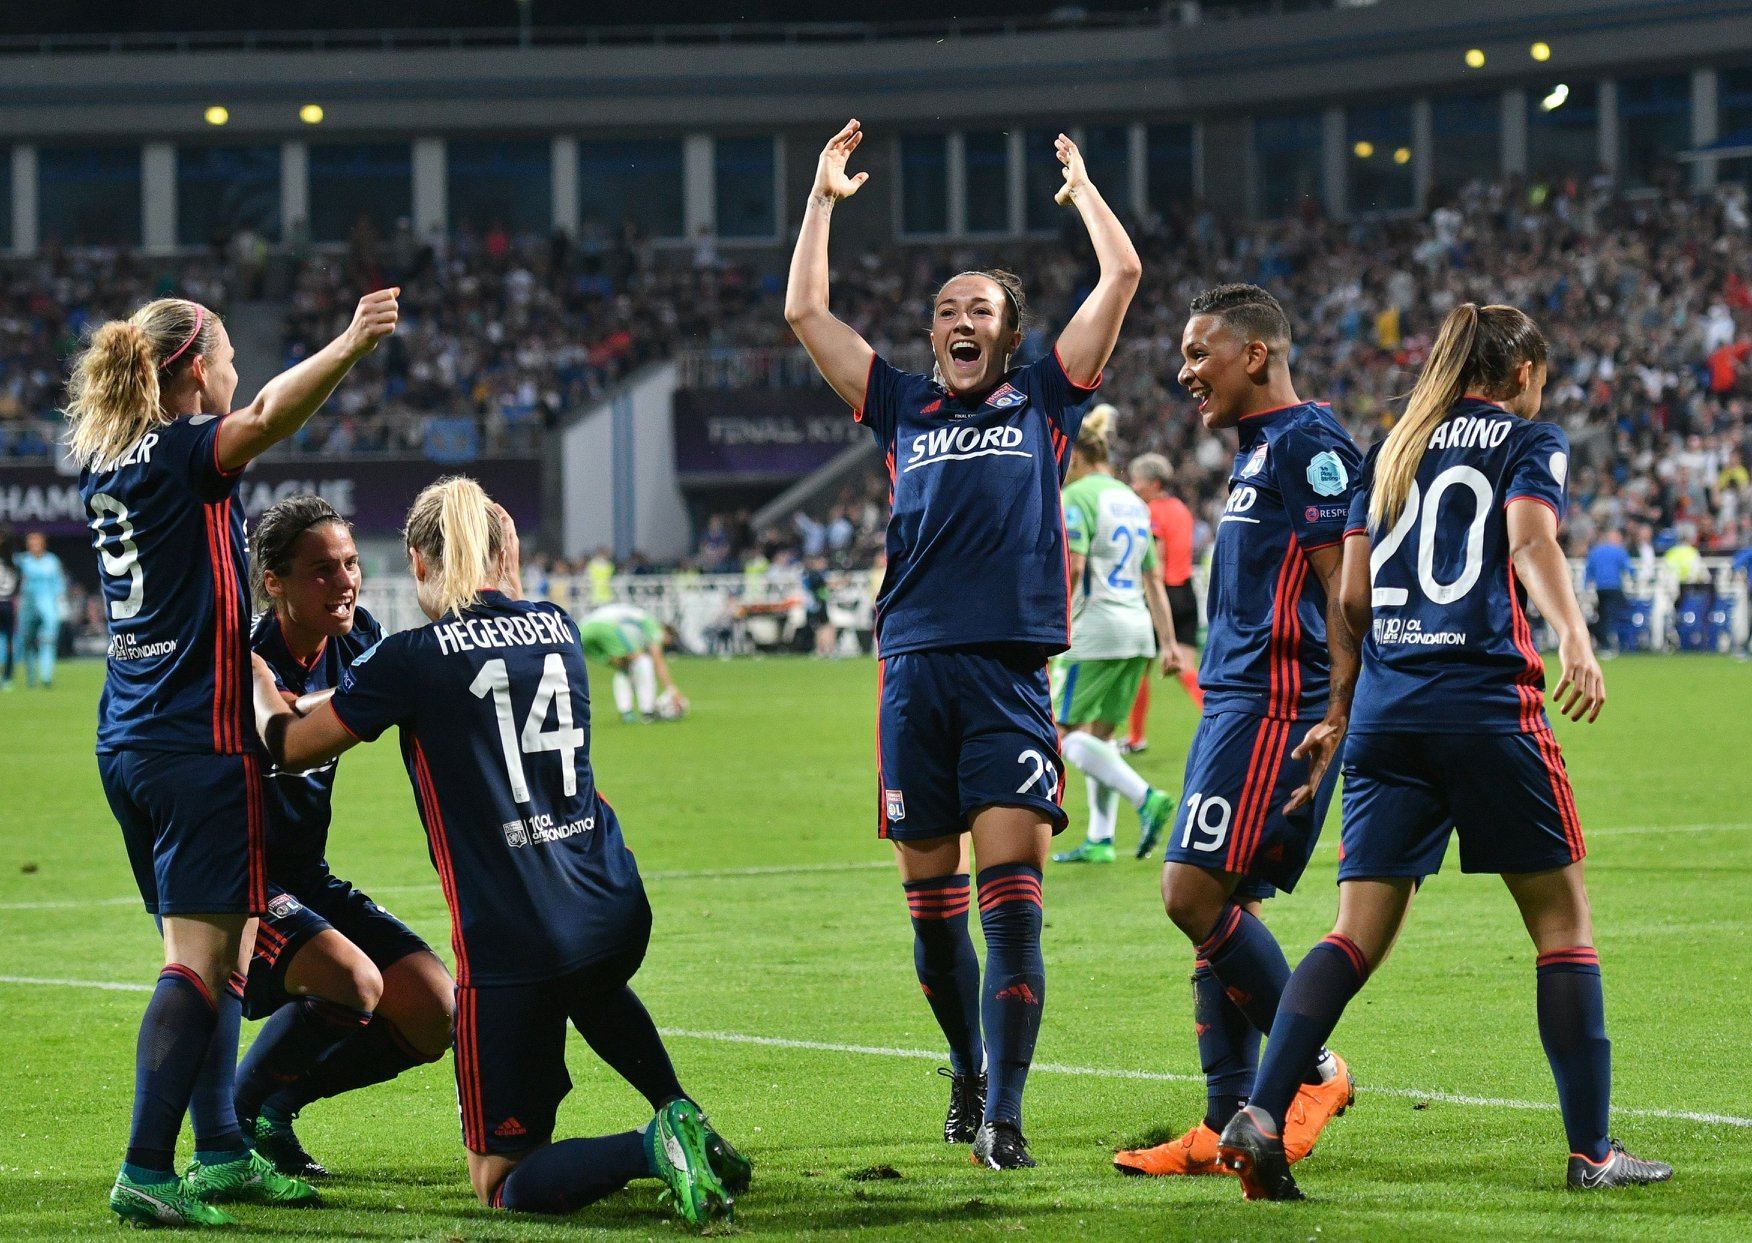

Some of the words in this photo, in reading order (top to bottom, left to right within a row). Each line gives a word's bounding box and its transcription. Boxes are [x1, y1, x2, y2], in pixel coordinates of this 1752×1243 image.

[907, 425, 1023, 463] SWORD
[1320, 508, 1348, 518] RESPE
[1370, 465, 1493, 606] 20
[90, 493, 144, 619] 9
[1386, 618, 1401, 633] 10
[1406, 620, 1422, 631] OL
[126, 633, 137, 646] OL
[1402, 632, 1466, 645] FONDATION
[469, 653, 584, 803] 14
[540, 813, 554, 828] OL
[1181, 793, 1232, 852] 19
